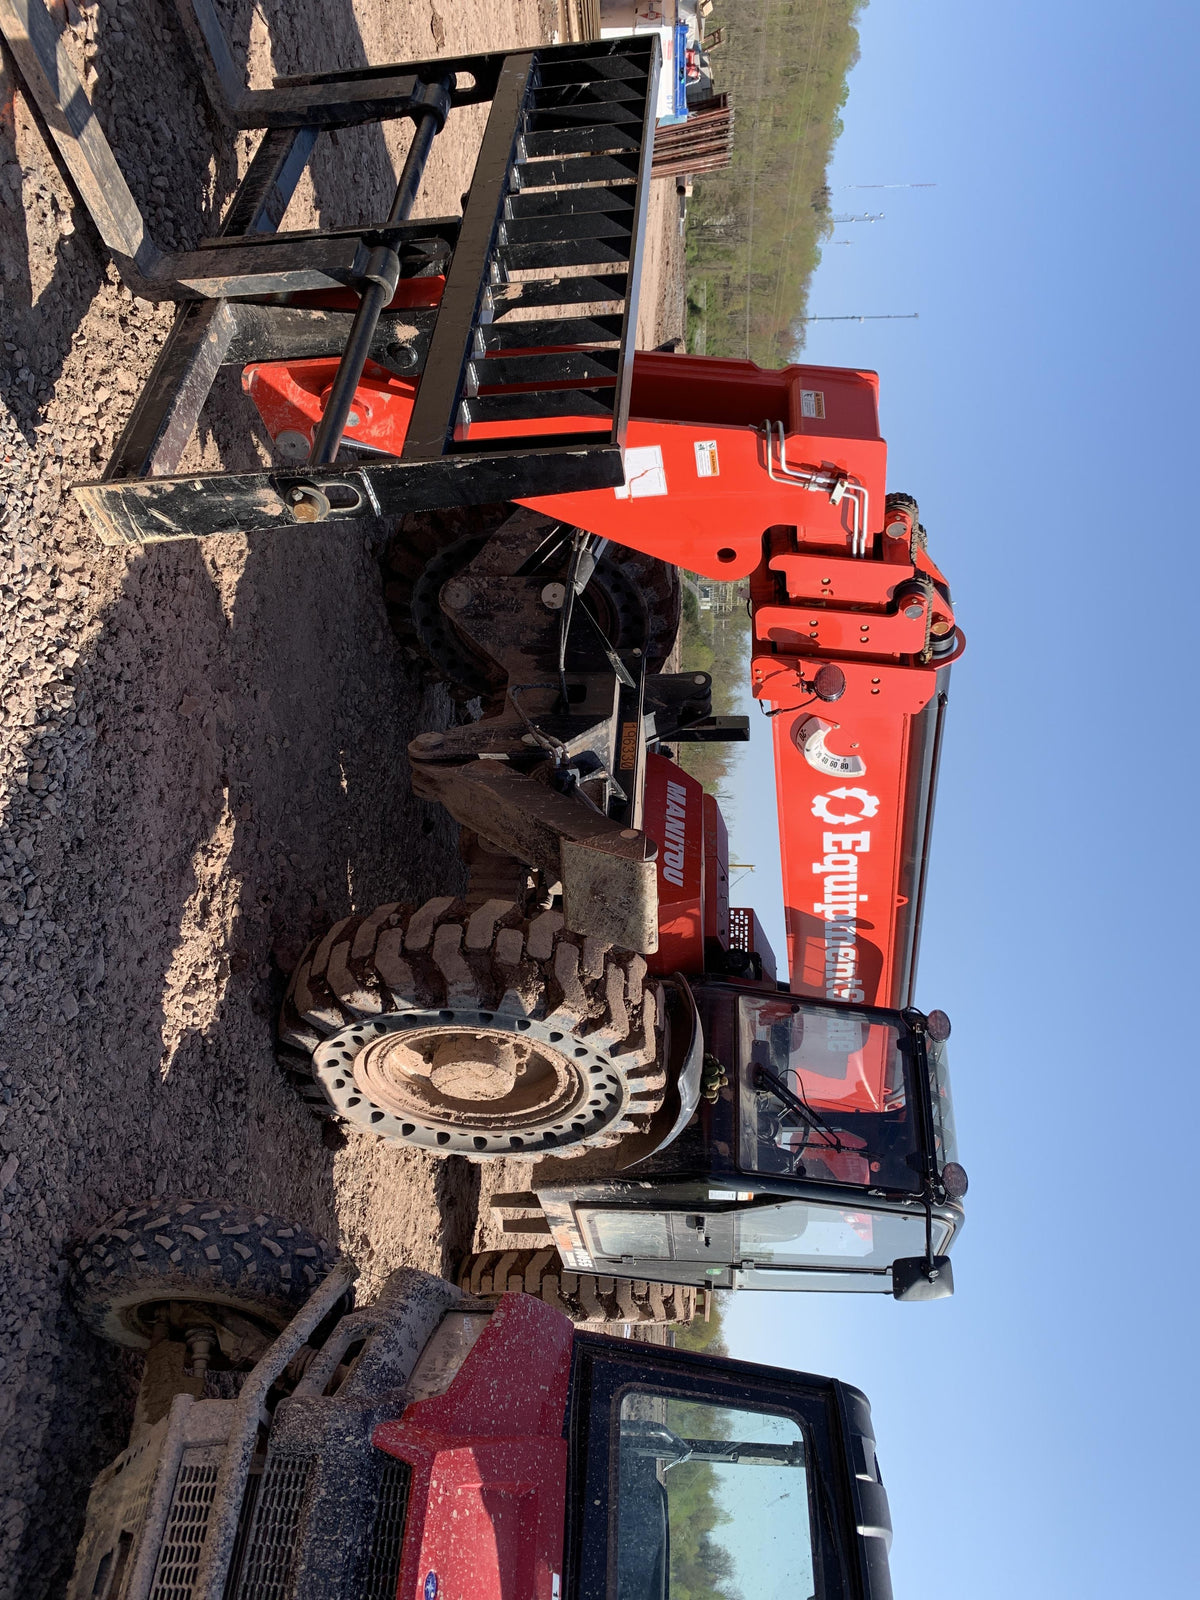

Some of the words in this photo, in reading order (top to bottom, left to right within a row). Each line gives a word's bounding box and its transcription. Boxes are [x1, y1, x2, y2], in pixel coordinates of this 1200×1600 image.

[621, 724, 636, 768] 196330
[663, 780, 687, 887] MANITOU
[812, 831, 870, 1053] EquipmentSare
